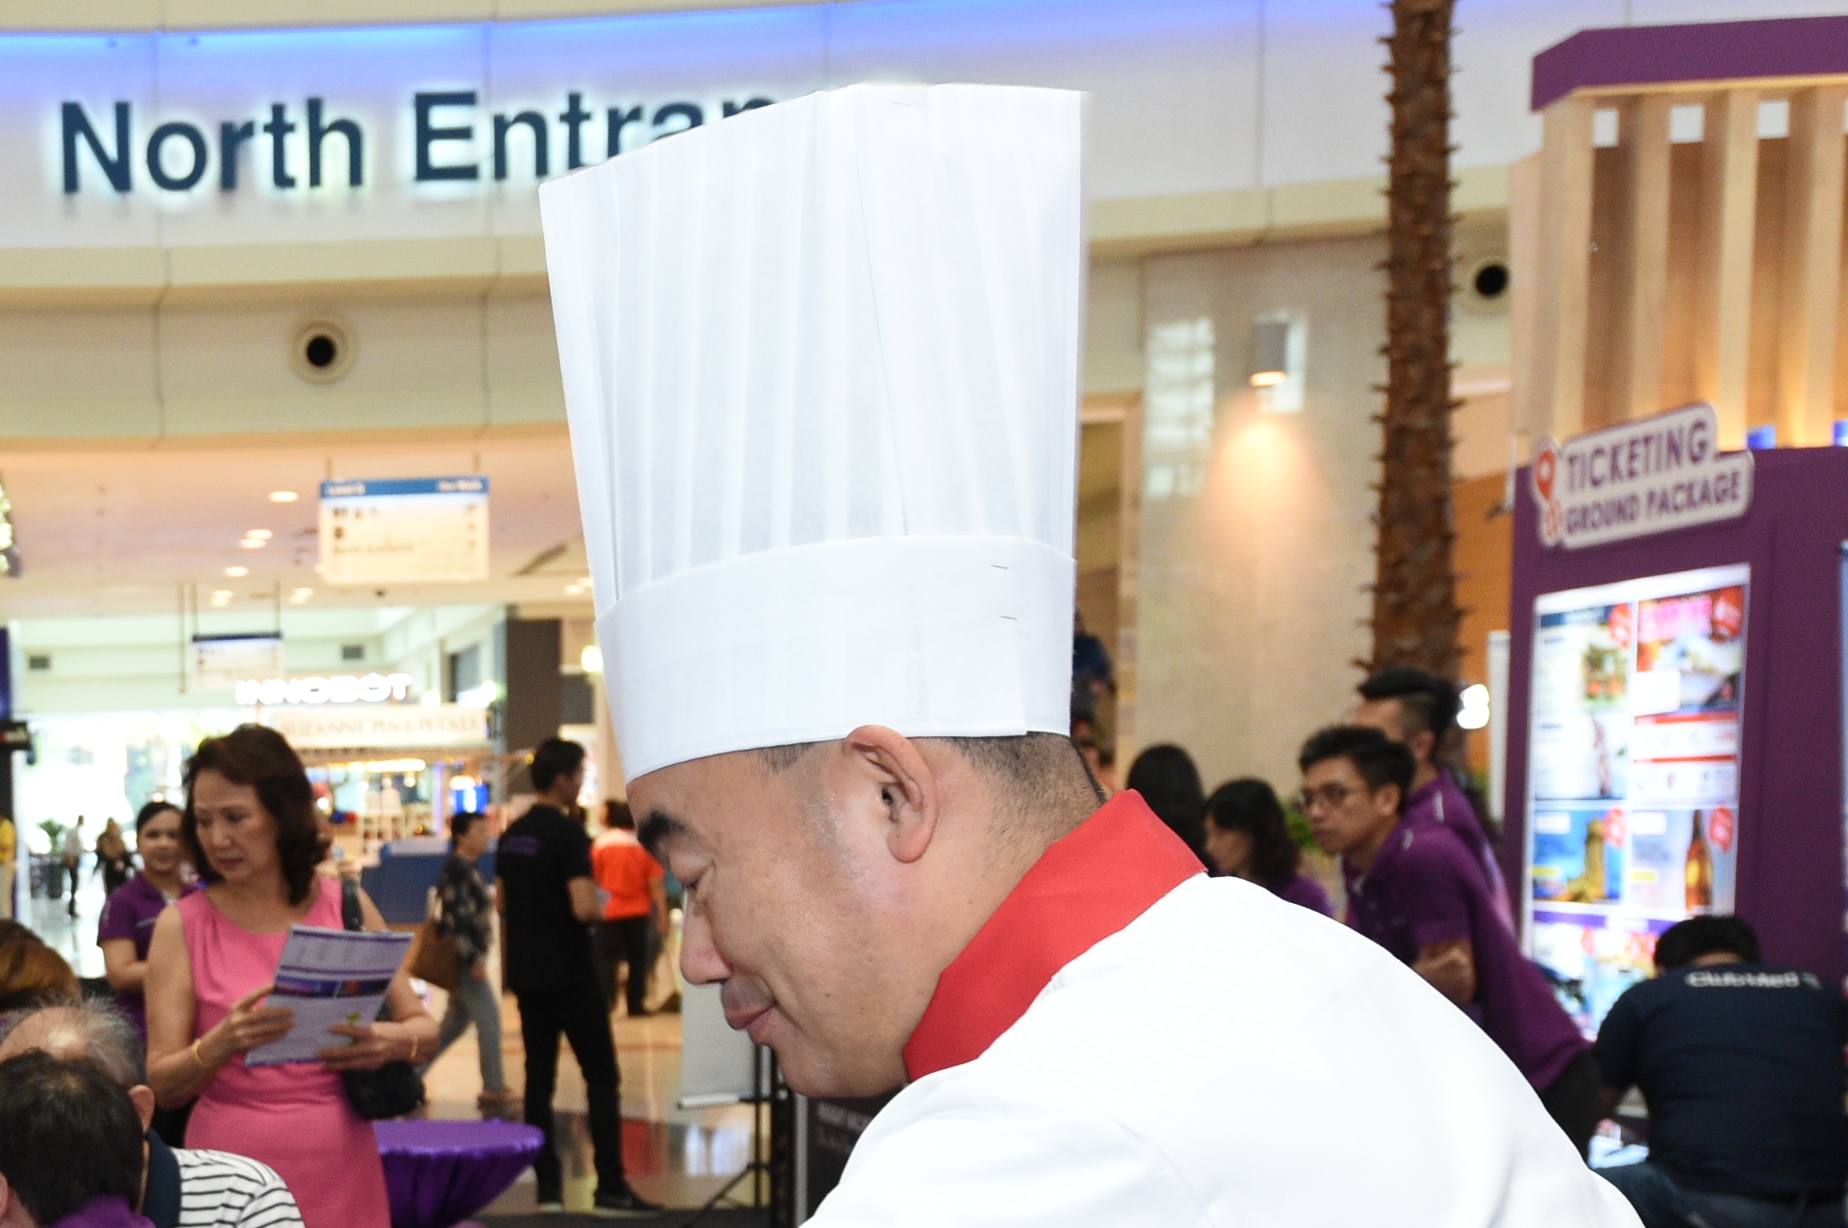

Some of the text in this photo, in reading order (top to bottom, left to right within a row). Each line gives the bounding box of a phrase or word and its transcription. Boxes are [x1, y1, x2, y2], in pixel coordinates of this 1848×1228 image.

[60, 91, 778, 193] North Entr
[1567, 419, 1708, 493] TICKETING
[1566, 470, 1740, 535] GROUND PACKAGE
